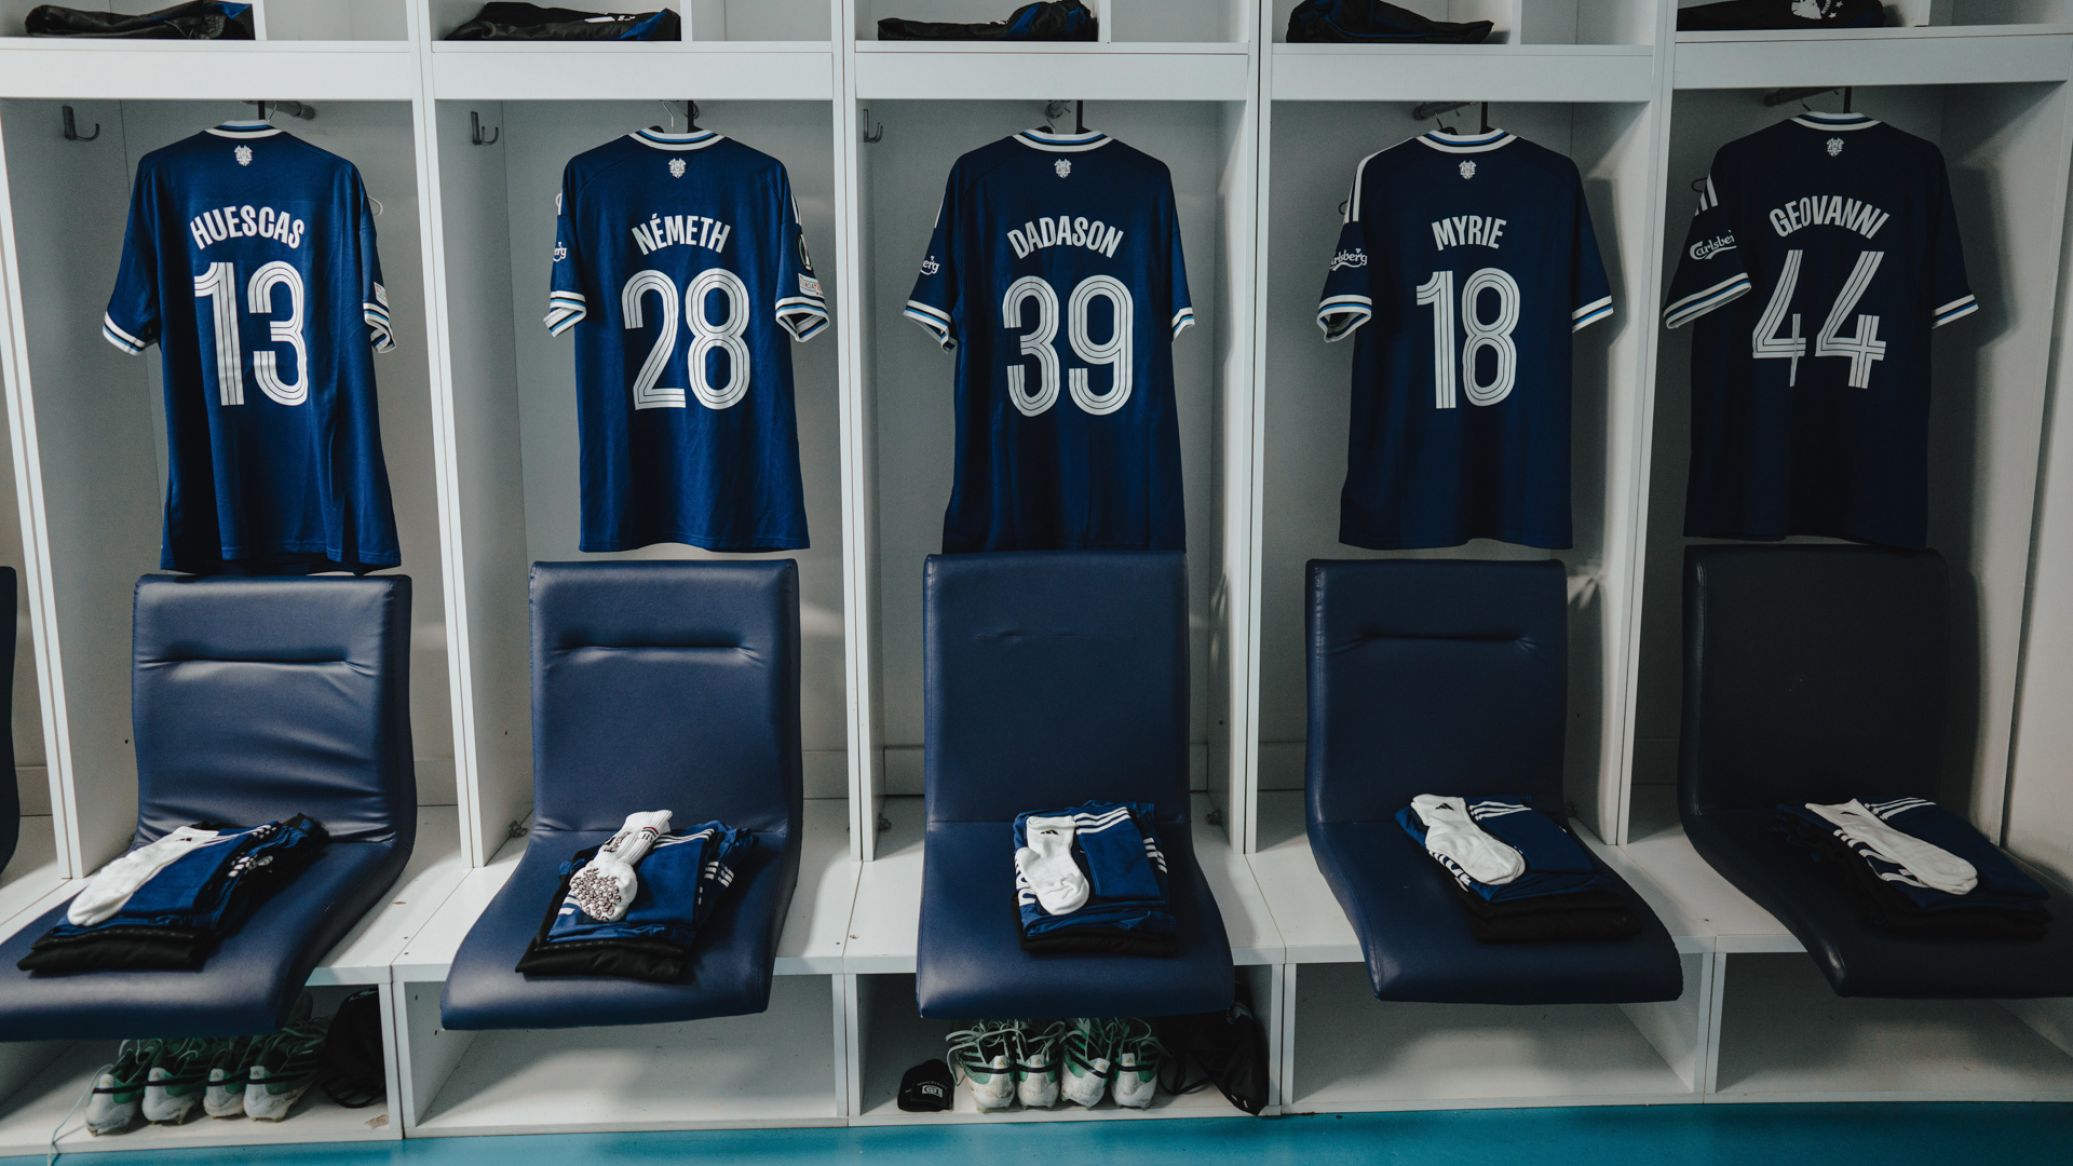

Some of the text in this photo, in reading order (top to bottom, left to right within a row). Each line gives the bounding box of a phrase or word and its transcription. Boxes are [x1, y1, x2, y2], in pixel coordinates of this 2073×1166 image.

[189, 205, 305, 250] HUESCAS
[631, 213, 731, 256] NÉMETH
[1007, 216, 1124, 259] DADASON
[1431, 215, 1507, 251] MYRIE
[1769, 195, 1890, 239] GEOVANNI
[193, 260, 309, 406] 13
[622, 267, 750, 410] 28
[1002, 275, 1134, 417] 39
[1416, 267, 1521, 409] 18
[1752, 249, 1887, 389] 44
